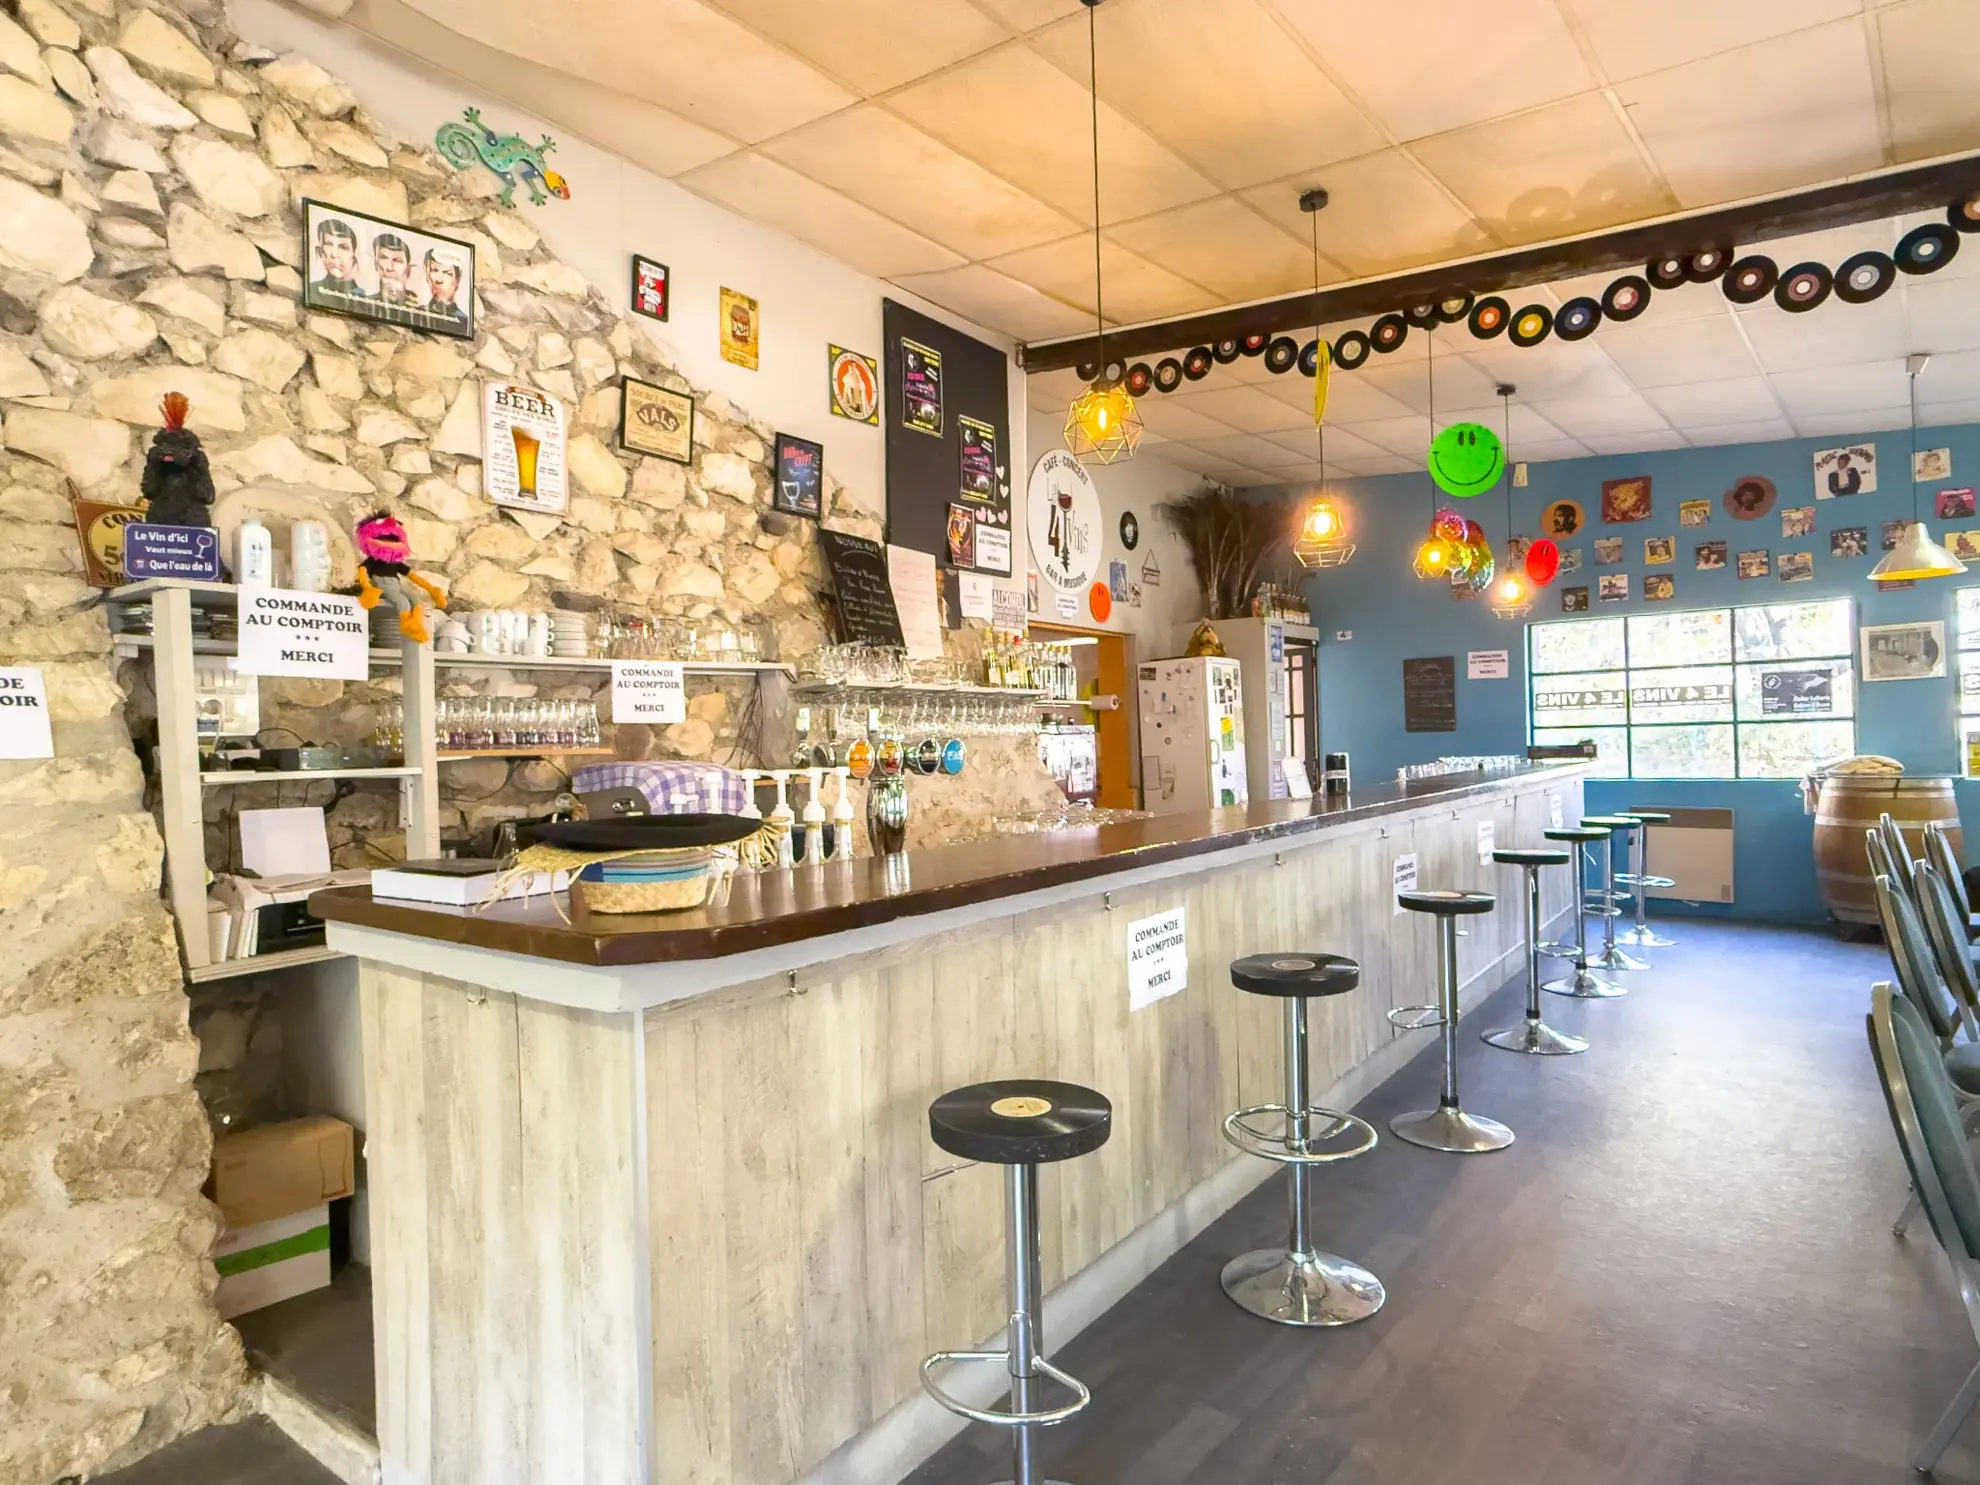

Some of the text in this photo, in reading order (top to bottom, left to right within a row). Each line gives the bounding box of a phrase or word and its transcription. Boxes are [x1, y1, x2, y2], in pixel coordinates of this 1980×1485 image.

[495, 390, 554, 417] BEER
[639, 407, 677, 431] VALS
[135, 531, 189, 543] Le Vin d'ici
[1048, 504, 1060, 557] 4
[144, 546, 166, 554] Vaut
[149, 560, 213, 572] Que l'eau de là
[1046, 563, 1058, 583] BAR
[255, 597, 354, 616] COMMANDE
[246, 614, 363, 633] AU COMPTOIR
[281, 649, 334, 663] MERCI
[621, 669, 674, 677] COMMANDE
[633, 681, 680, 689] COMPTOIR
[634, 704, 665, 712] MERCI
[1135, 919, 1180, 943] COMMANDE
[1131, 934, 1184, 962] AU COMPTOIR
[1147, 969, 1171, 989] MERCI
